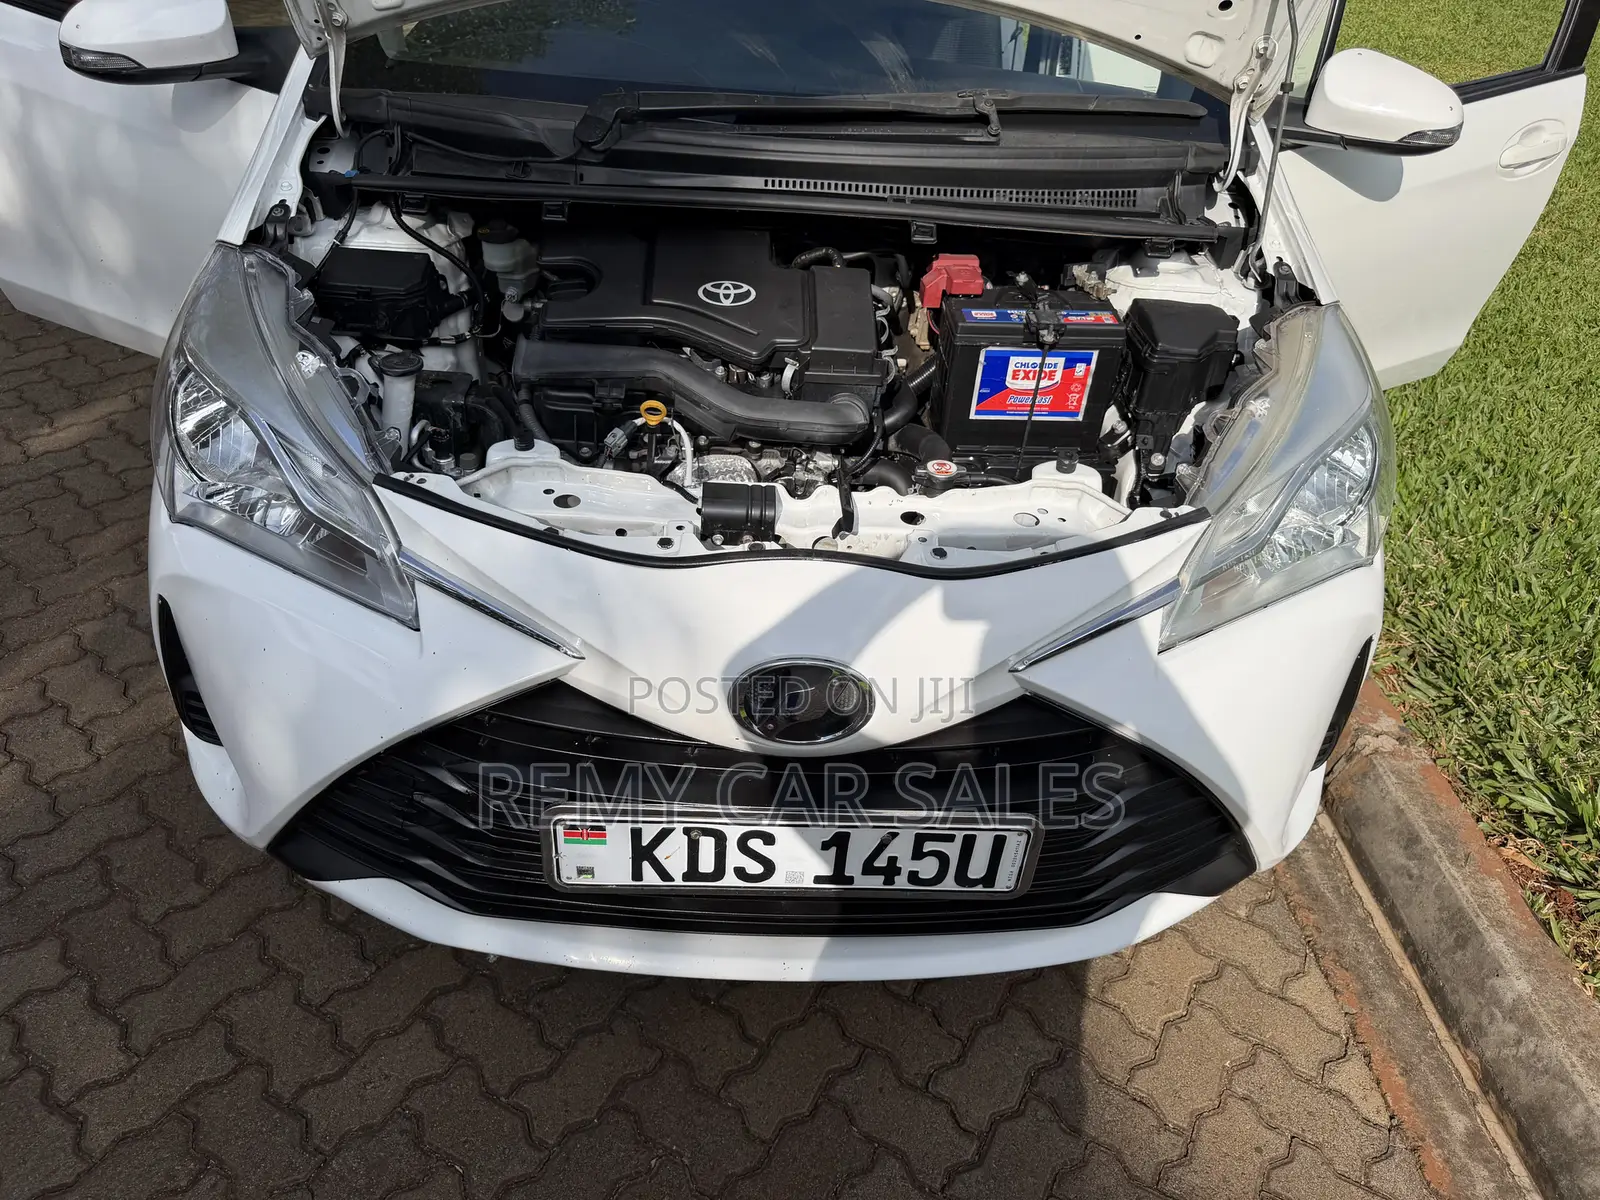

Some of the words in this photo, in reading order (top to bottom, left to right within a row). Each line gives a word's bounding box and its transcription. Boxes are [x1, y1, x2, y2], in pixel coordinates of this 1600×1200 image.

[1014, 361, 1059, 369] CHLOIDE
[1007, 394, 1053, 404] Powerast
[630, 826, 777, 884] KDS
[812, 831, 1008, 889] 145U
